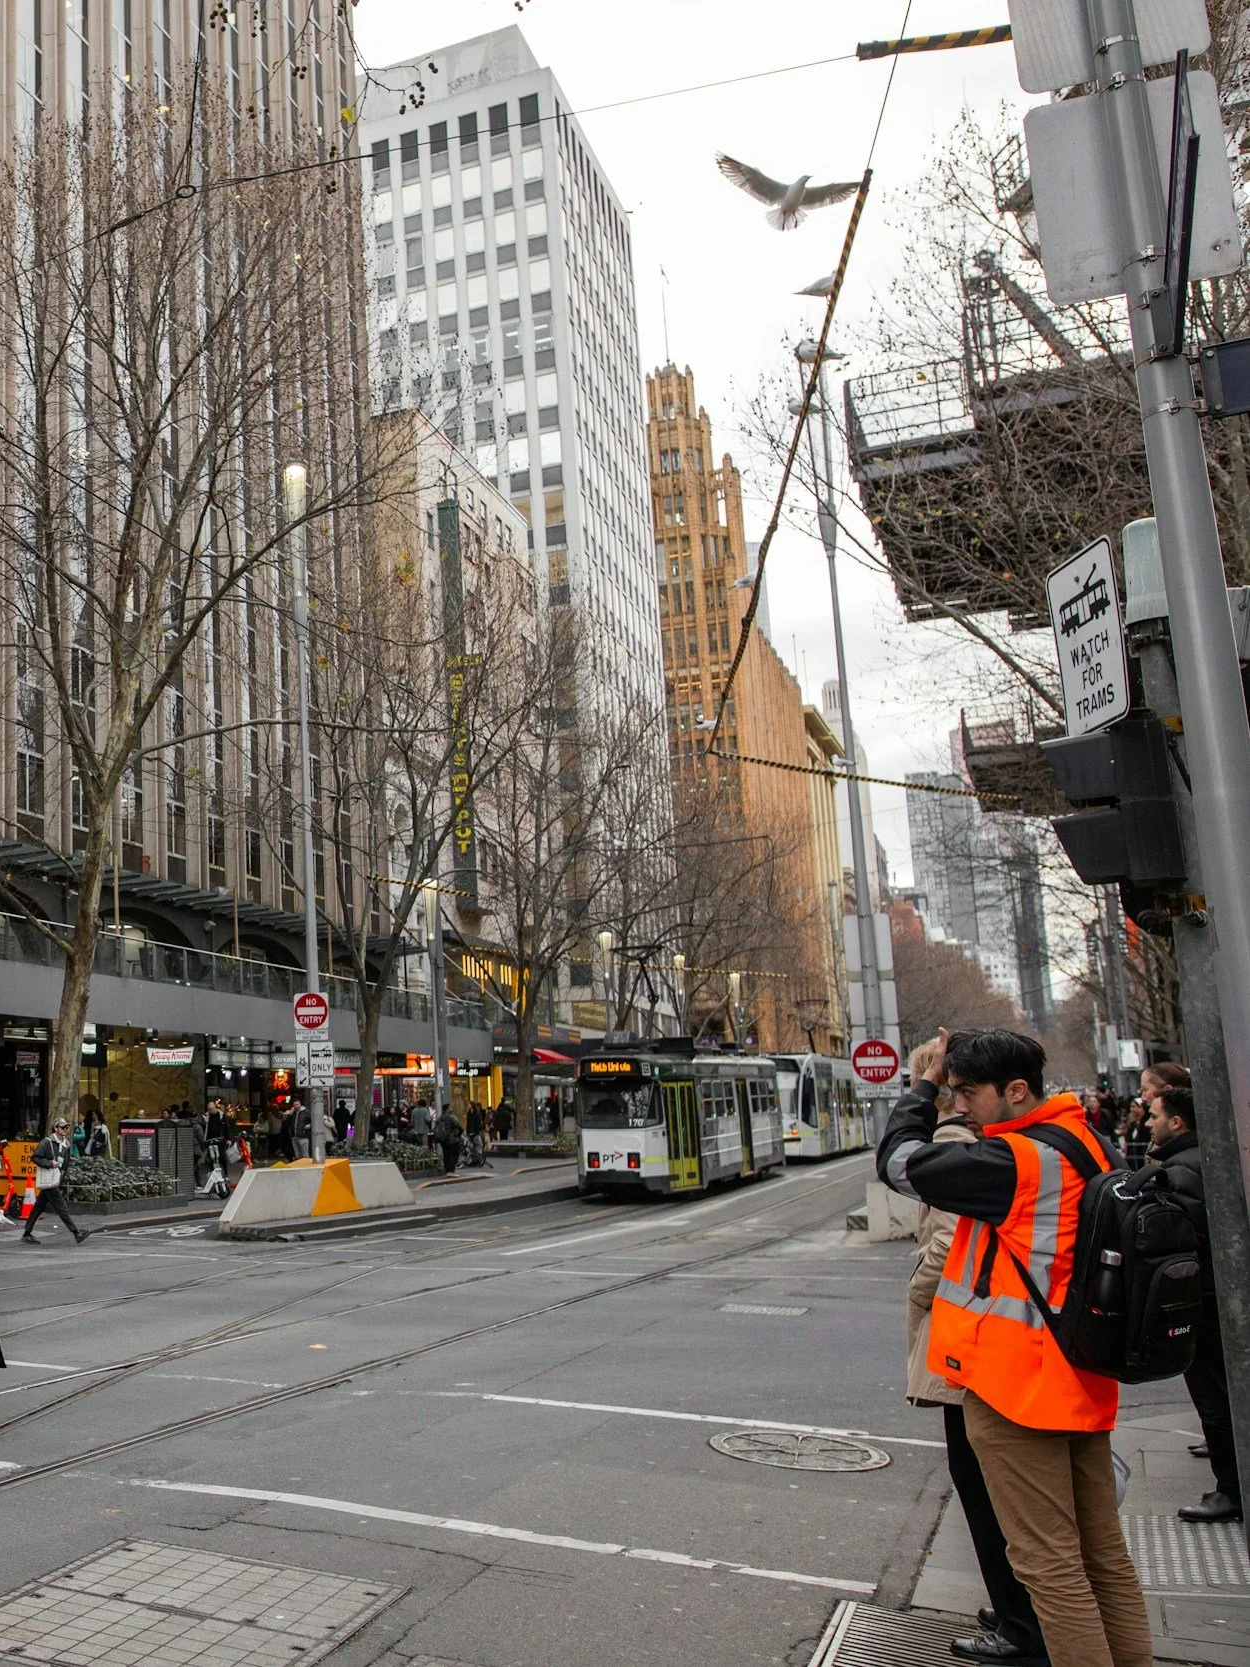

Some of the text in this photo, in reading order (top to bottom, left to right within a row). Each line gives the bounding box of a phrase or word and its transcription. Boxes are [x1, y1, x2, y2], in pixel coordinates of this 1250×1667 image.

[1070, 629, 1109, 668] WATCH
[1082, 662, 1103, 689] FOR
[1076, 683, 1115, 720] TRAMS
[305, 997, 317, 1006] NO
[299, 1016, 324, 1024] ENTRY
[150, 1050, 192, 1061] Krispy Kreme
[867, 1046, 883, 1056] NO
[311, 1063, 331, 1072] ONLY
[860, 1067, 893, 1078] ENTRY
[628, 1118, 644, 1127] 170
[21, 1166, 37, 1175] WOR
